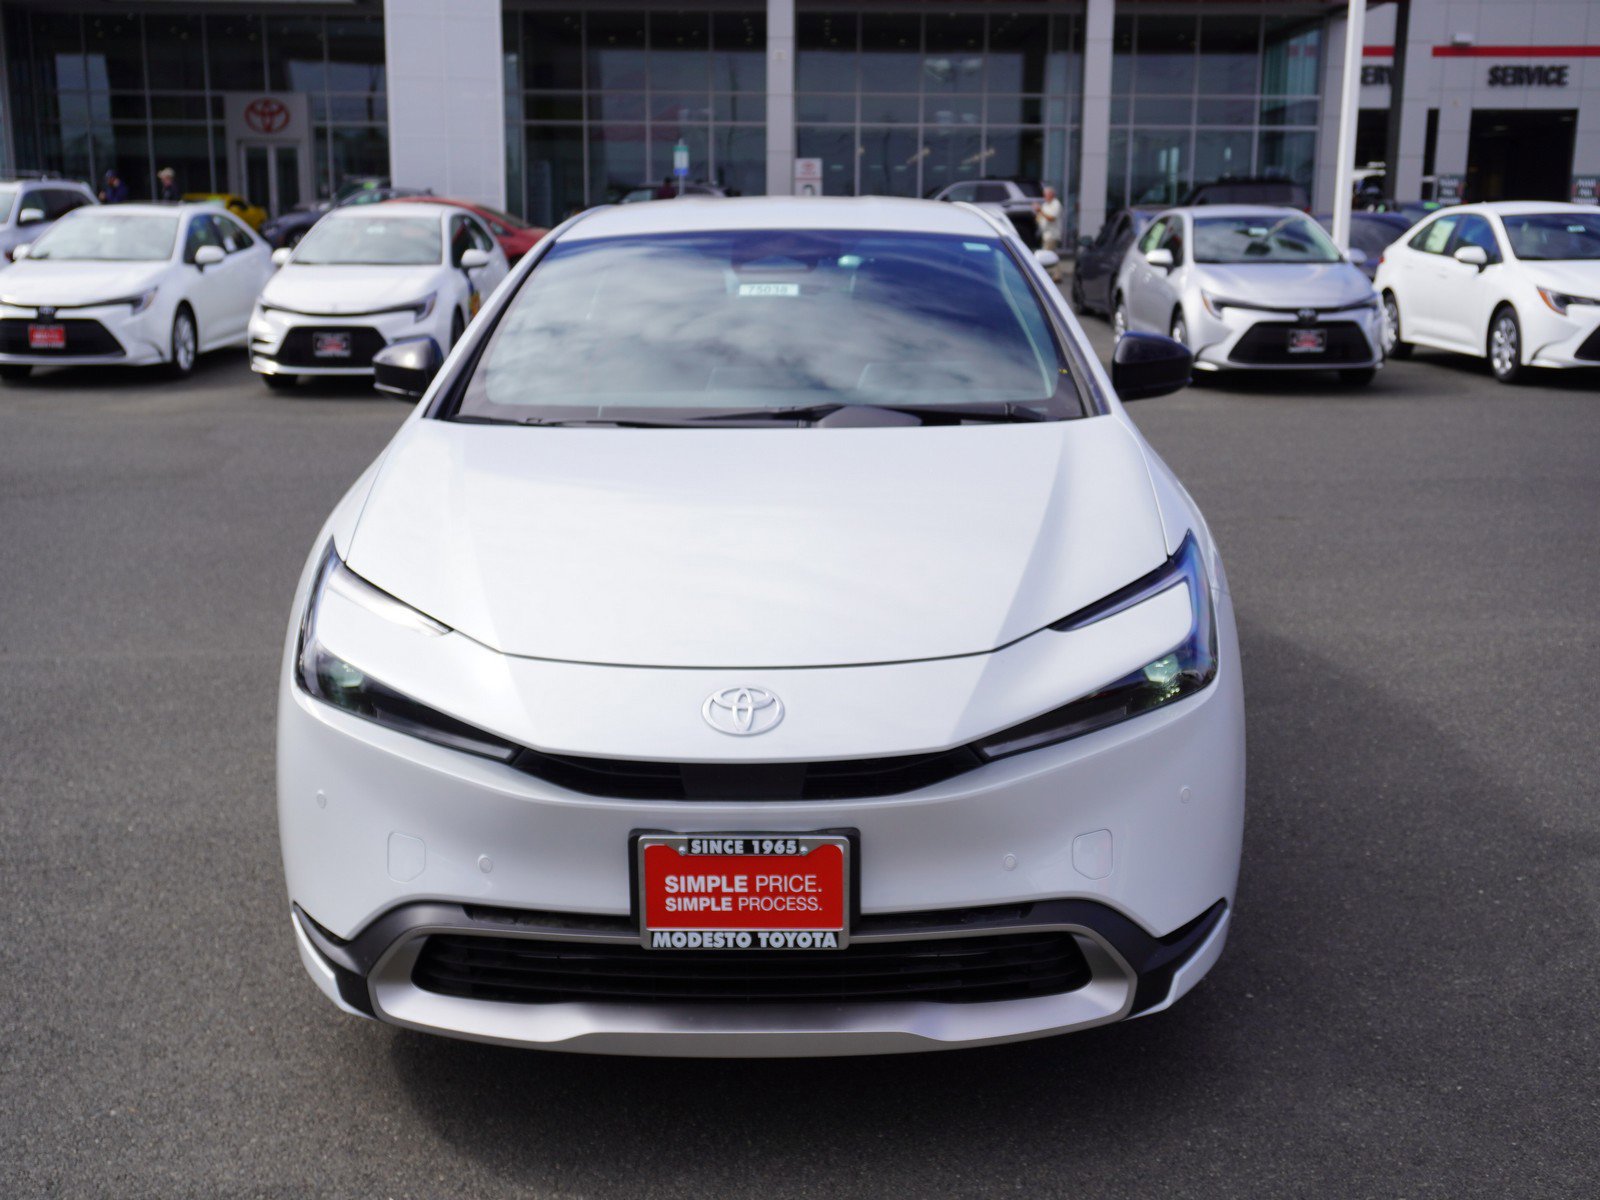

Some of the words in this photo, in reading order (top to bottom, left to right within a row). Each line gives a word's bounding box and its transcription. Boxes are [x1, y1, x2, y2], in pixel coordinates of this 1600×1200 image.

[1488, 66, 1568, 86] SERVICE
[690, 839, 744, 855] SINCE
[752, 839, 797, 855] 1965
[664, 875, 748, 893] SIMPLE
[755, 875, 822, 893] PRICE.
[665, 896, 732, 912] SIMPLE
[738, 896, 823, 912] PROCESS.
[652, 931, 751, 949] MODESTO
[757, 931, 838, 948] TOYOTA
